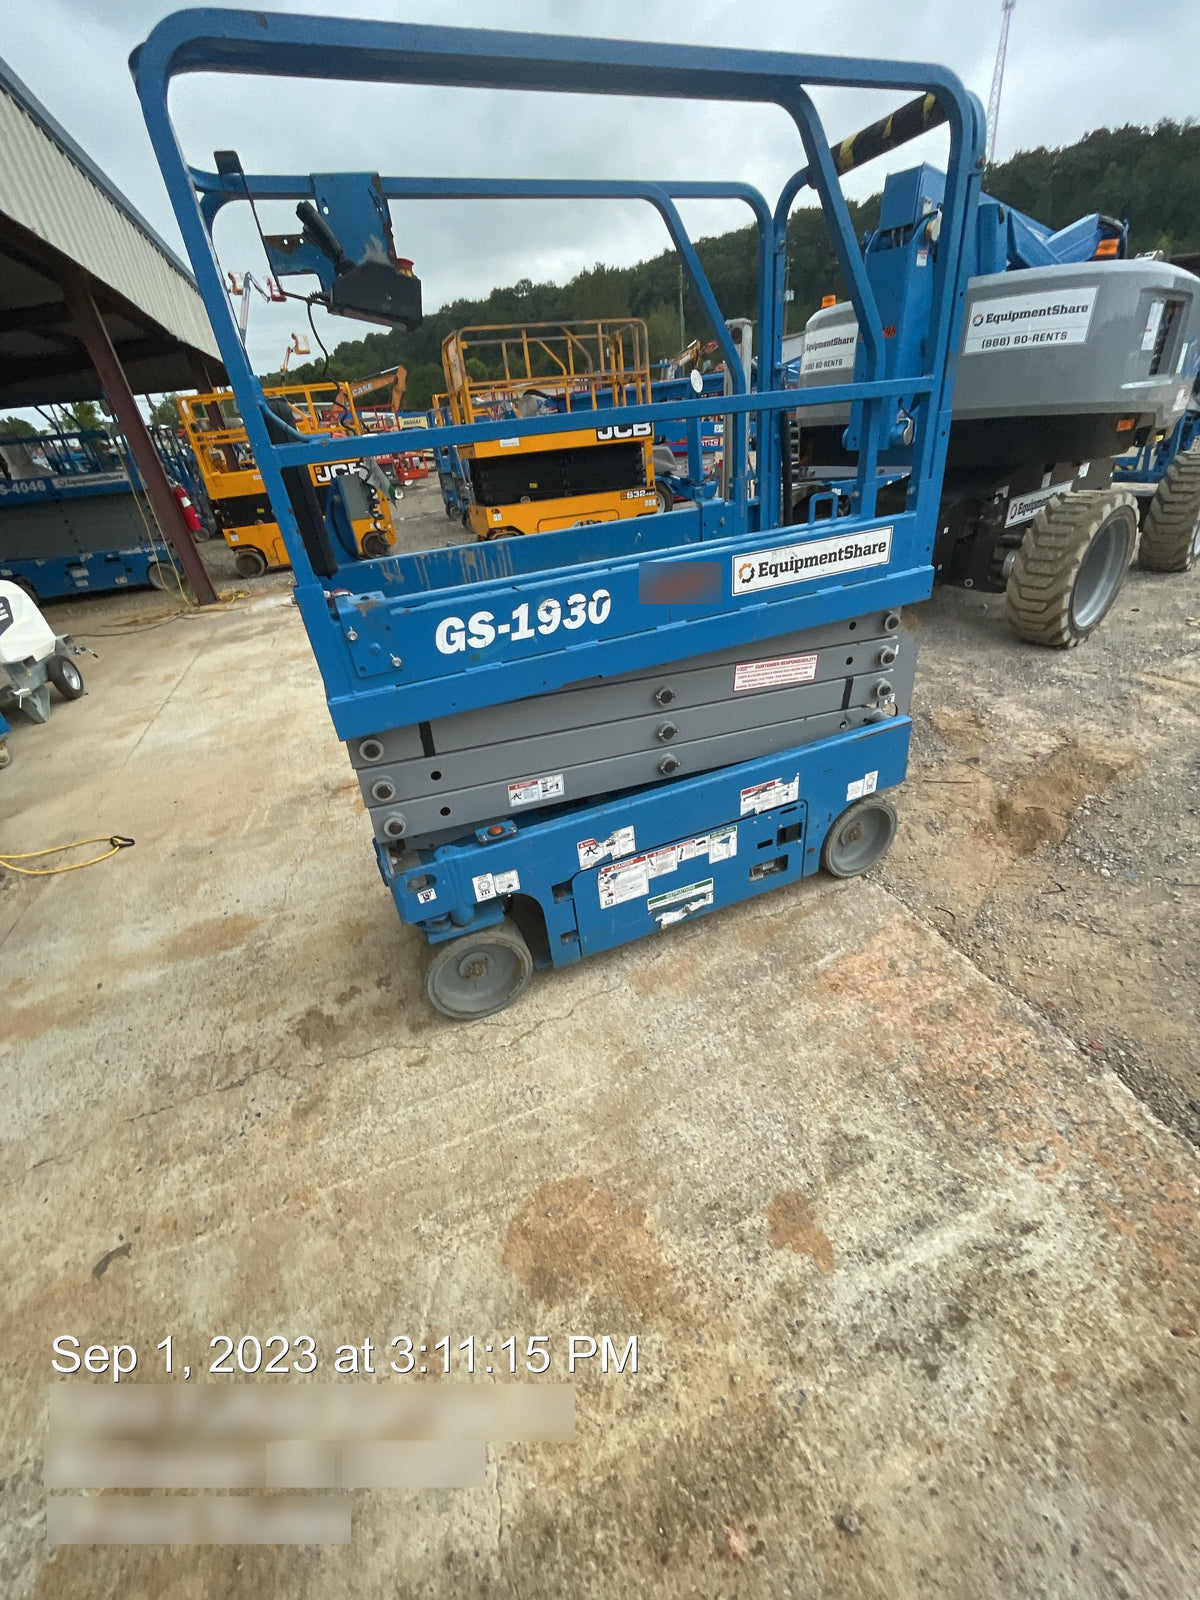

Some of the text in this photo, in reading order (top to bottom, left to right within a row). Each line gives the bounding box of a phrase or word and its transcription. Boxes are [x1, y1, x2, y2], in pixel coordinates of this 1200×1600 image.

[986, 304, 1089, 324] EquipmentShare
[981, 331, 1068, 349] (888) 80-RENTS
[352, 383, 374, 396] CASE
[758, 541, 887, 578] EquipmentShare
[435, 589, 612, 655] GS-1930
[615, 859, 634, 870] DANGER
